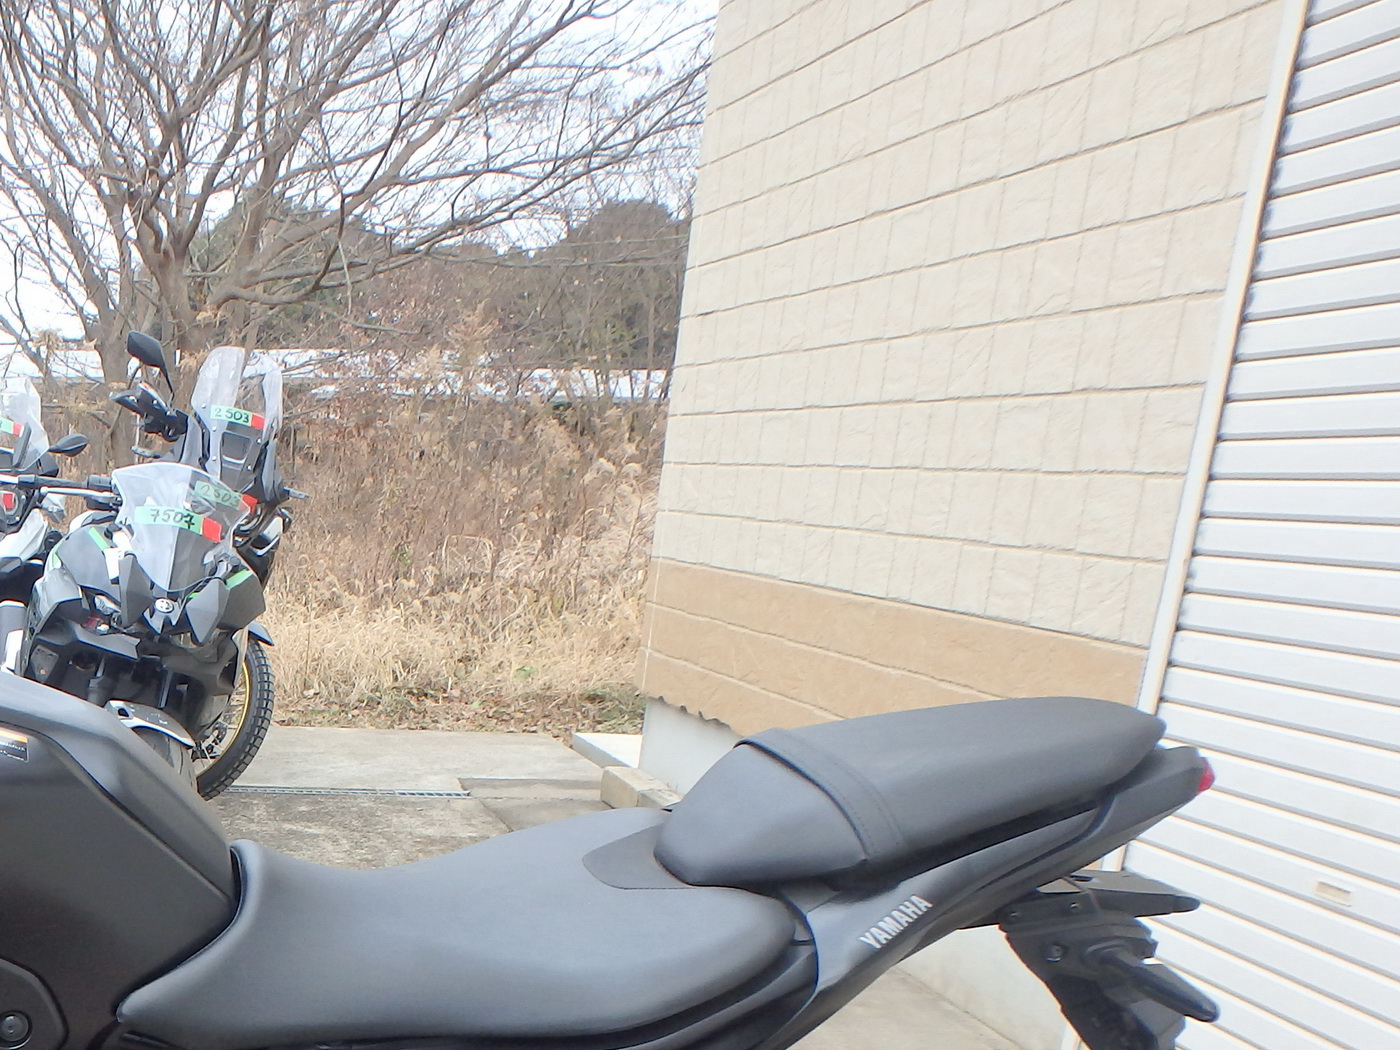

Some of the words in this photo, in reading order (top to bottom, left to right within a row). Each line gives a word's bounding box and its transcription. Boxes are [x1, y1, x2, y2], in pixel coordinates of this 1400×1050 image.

[214, 408, 250, 424] 2503
[150, 509, 196, 530] 7507
[858, 894, 934, 949] YAMAHA
